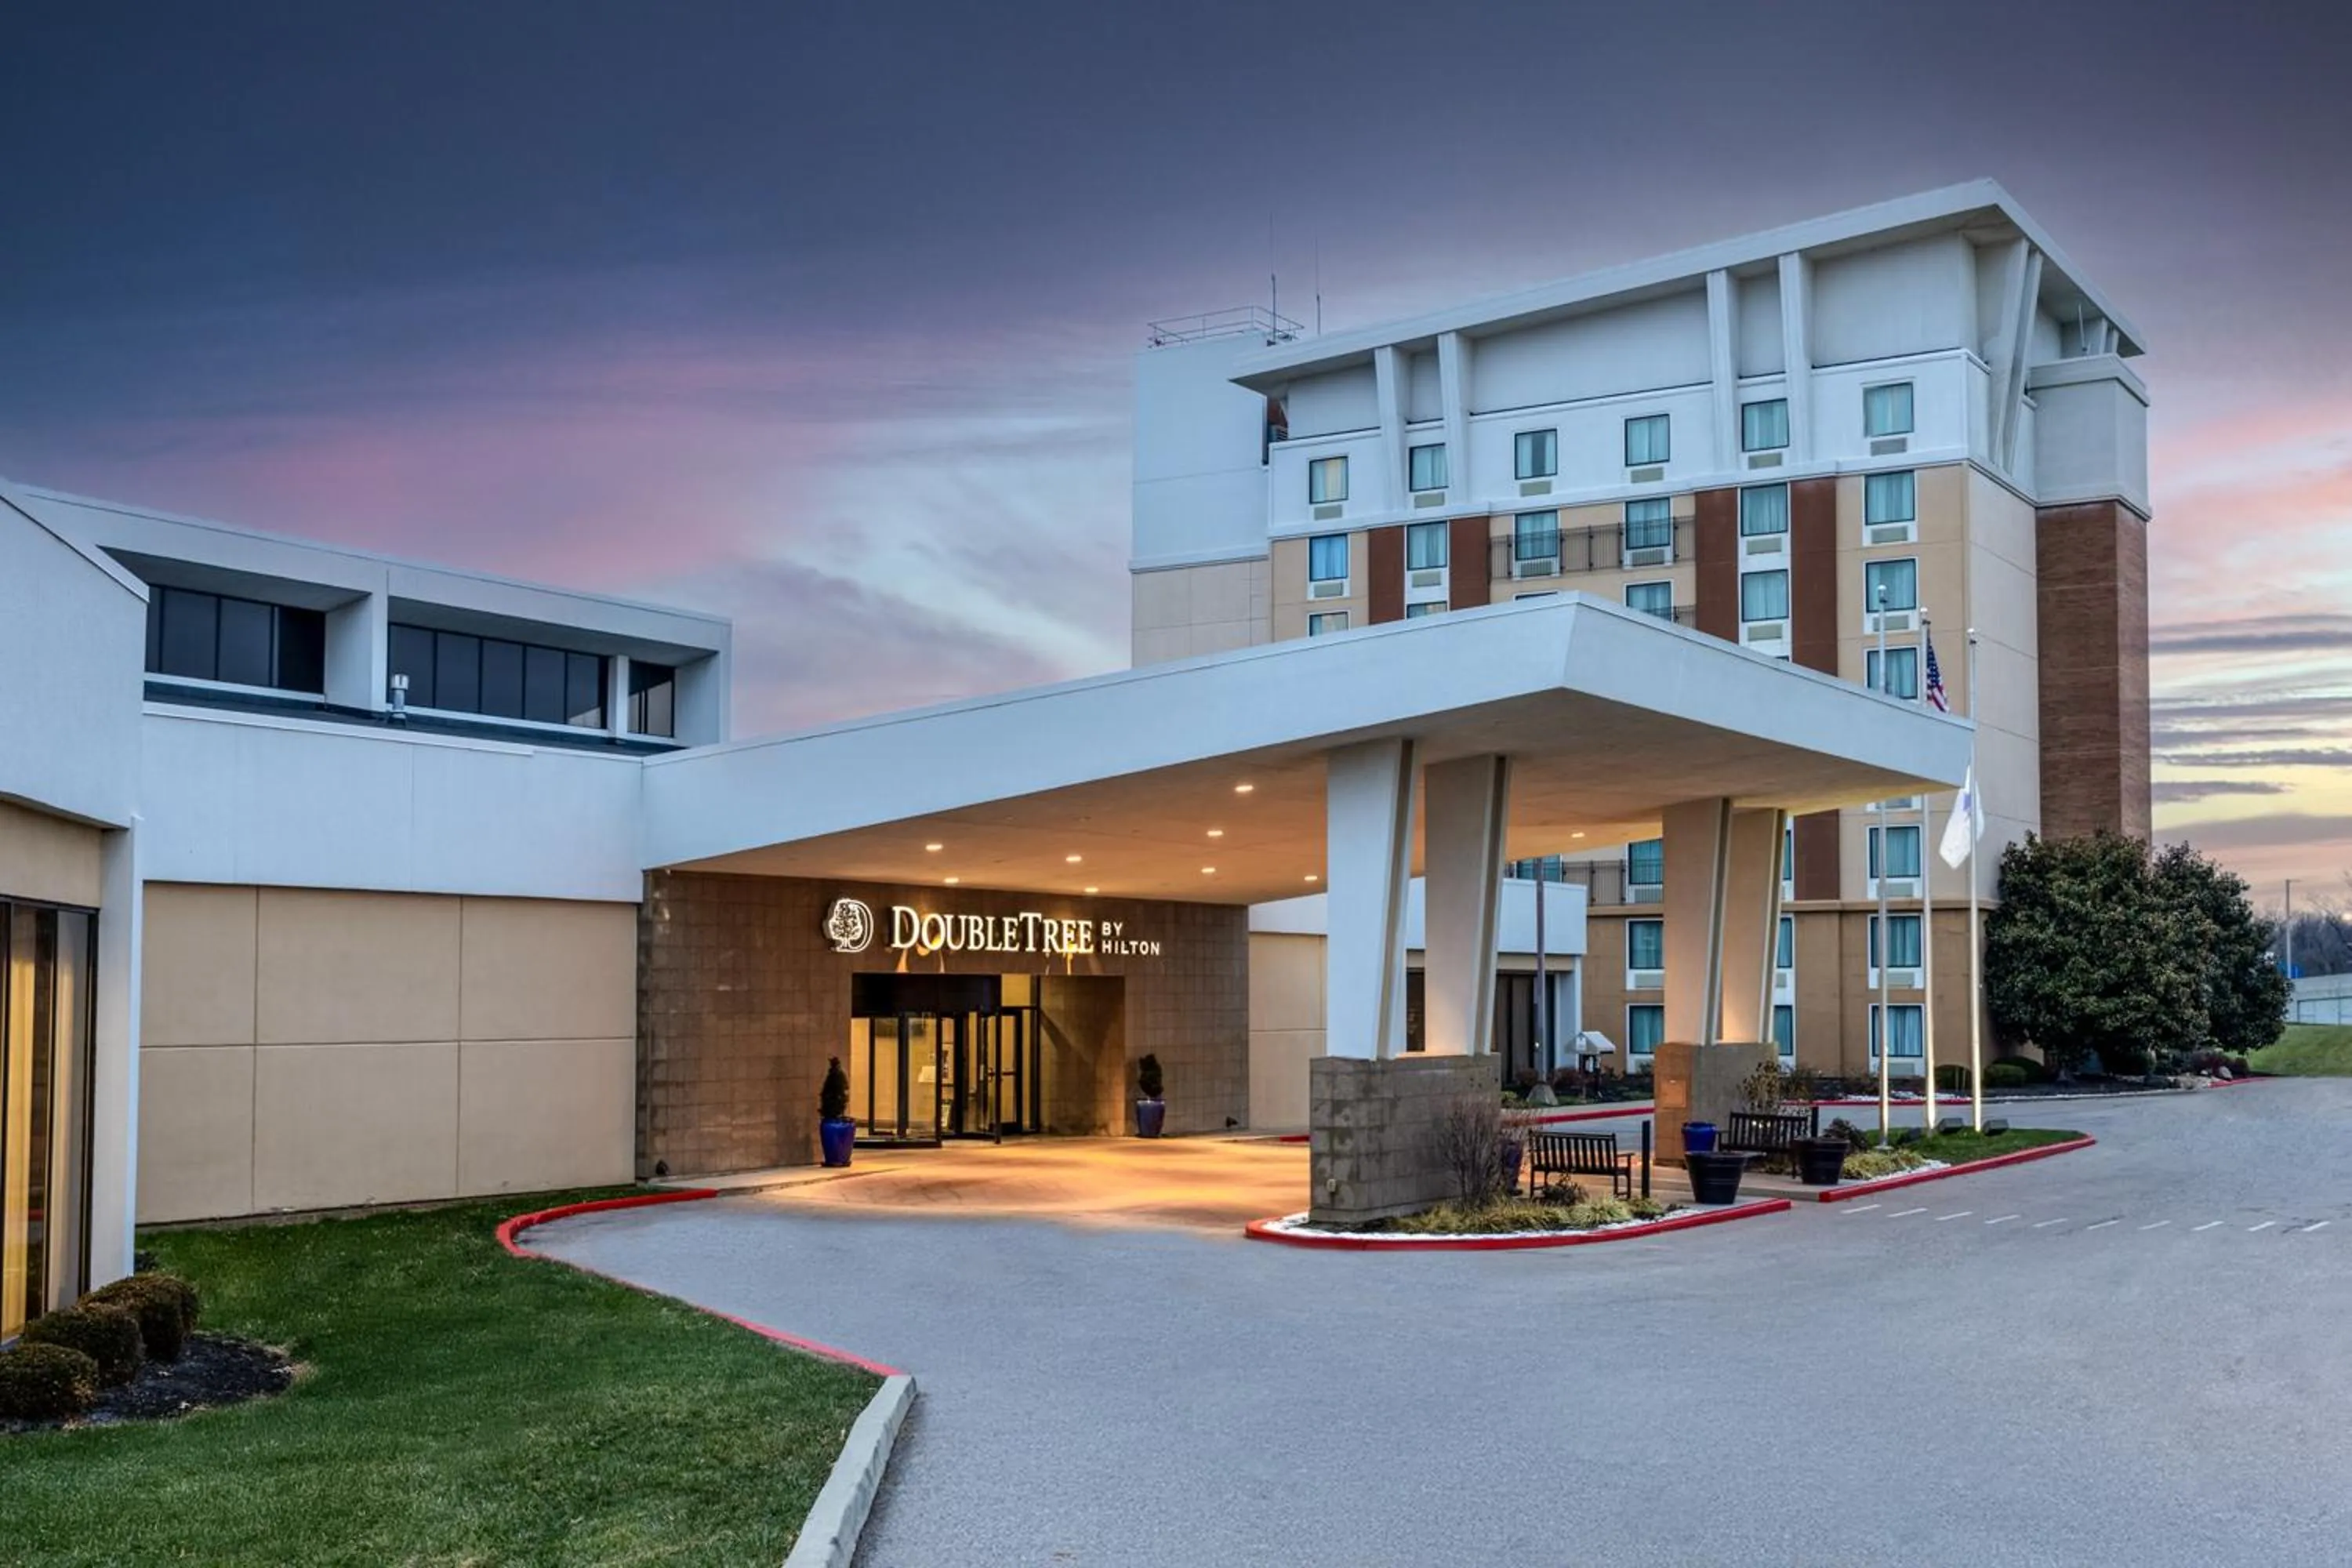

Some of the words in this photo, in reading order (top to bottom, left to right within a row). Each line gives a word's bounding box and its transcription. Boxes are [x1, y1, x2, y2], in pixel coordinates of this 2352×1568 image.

[891, 906, 1094, 954] DOUBLETREE
[1102, 921, 1123, 936] BY
[1102, 940, 1160, 956] HILTON
